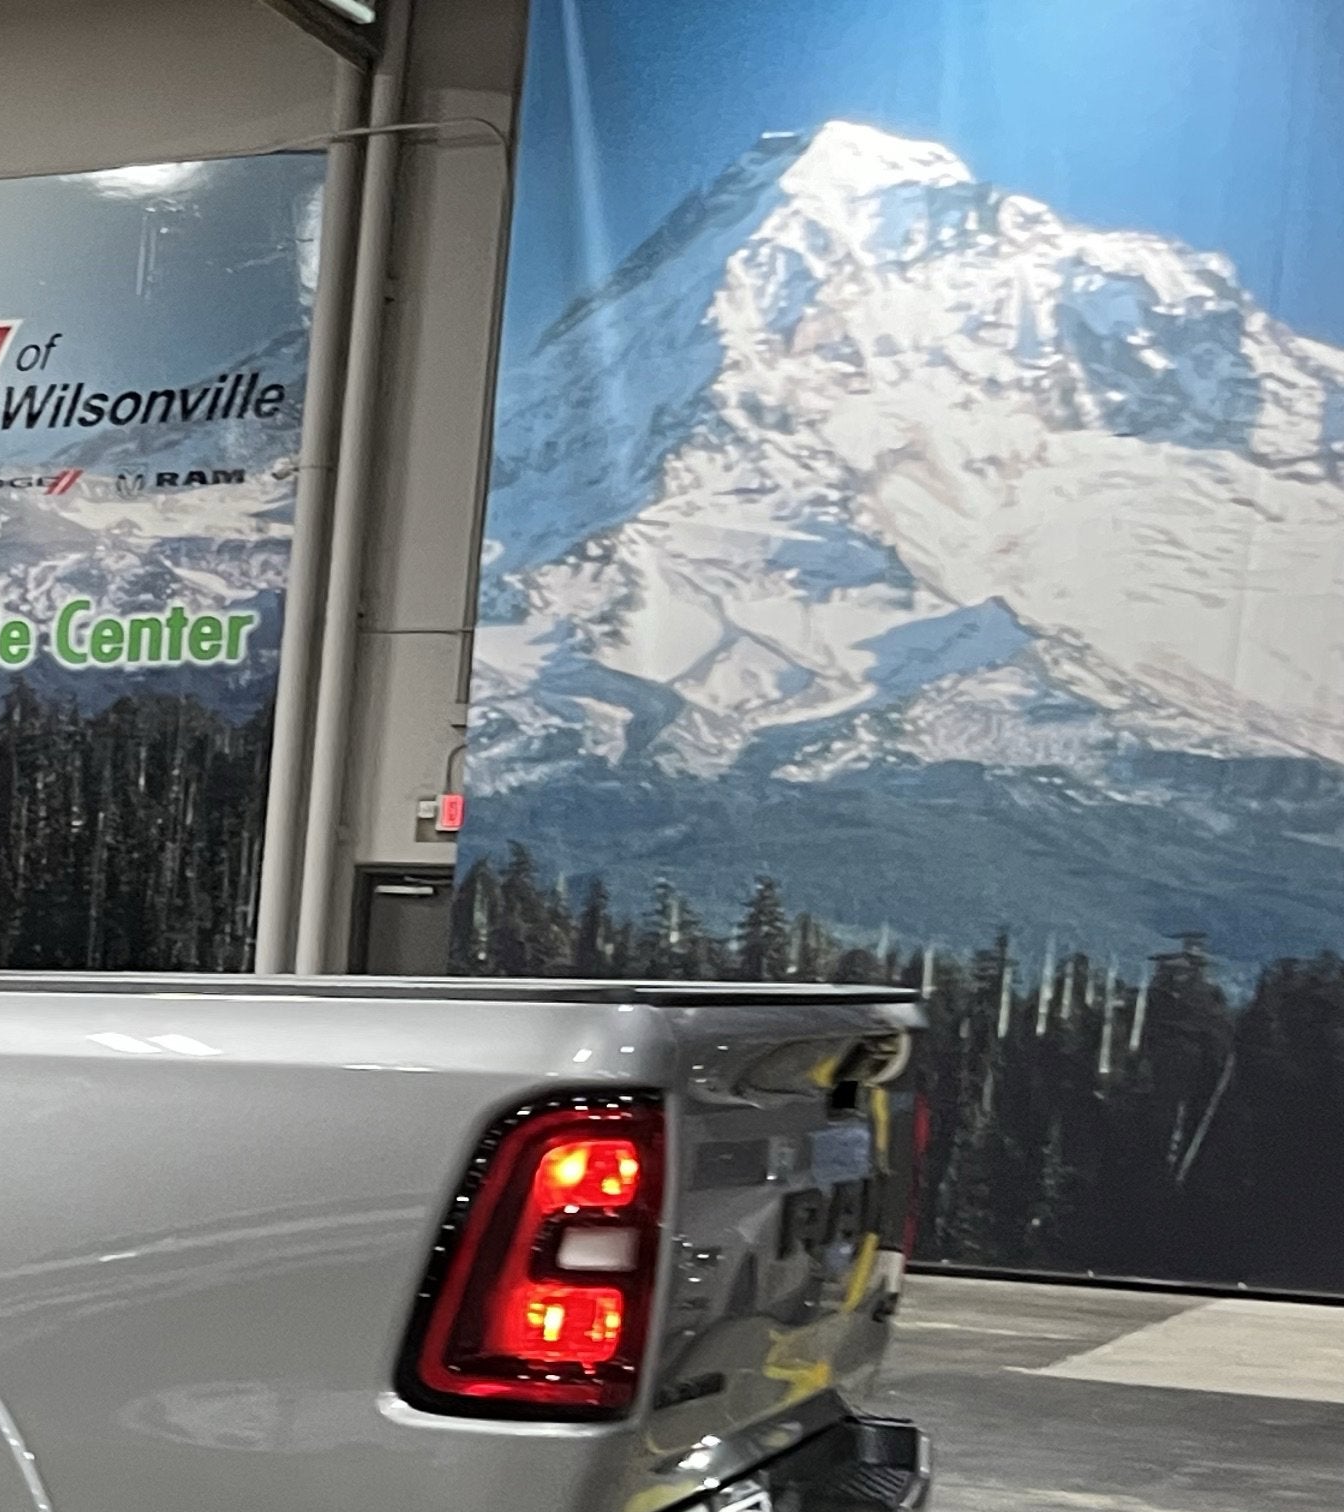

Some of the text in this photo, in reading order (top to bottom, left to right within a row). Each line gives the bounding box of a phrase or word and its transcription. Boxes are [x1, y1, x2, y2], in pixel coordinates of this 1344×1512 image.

[16, 333, 63, 372] of
[1, 371, 286, 430] Wilsonville
[156, 468, 246, 488] RAM
[56, 599, 255, 664] Center
